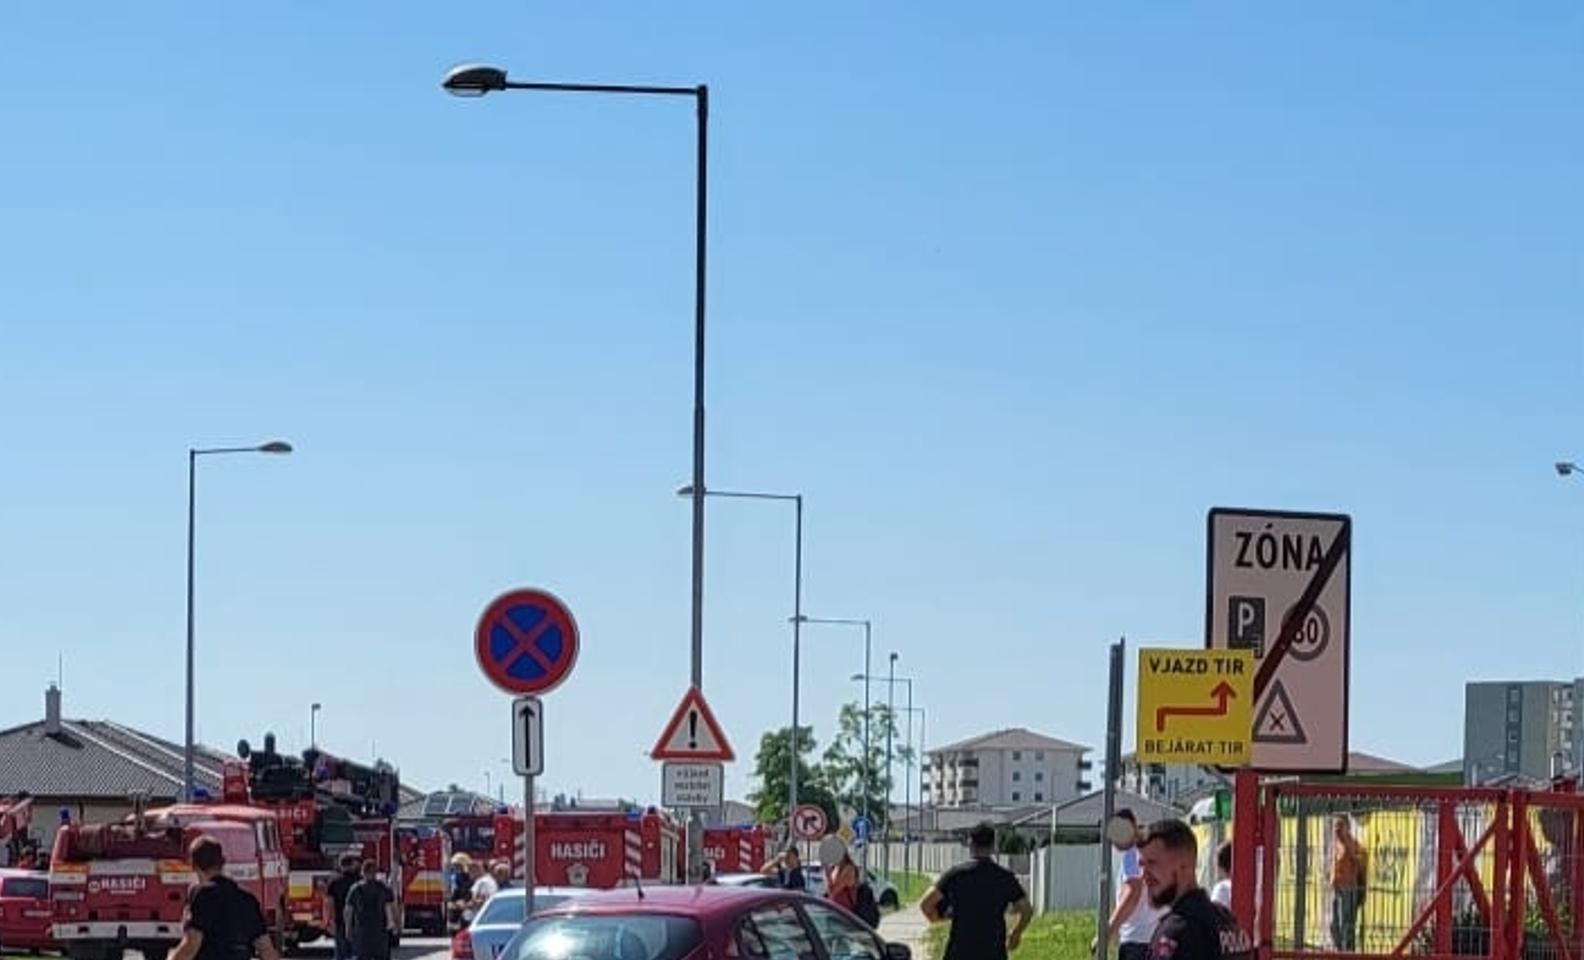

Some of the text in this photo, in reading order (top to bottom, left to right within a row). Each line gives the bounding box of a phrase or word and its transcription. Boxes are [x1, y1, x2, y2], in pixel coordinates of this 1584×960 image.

[1234, 523, 1329, 571] ZÓNA
[1149, 658, 1244, 675] VJAZD TIR
[1144, 737, 1244, 754] BEJÁRAT TIR
[551, 837, 605, 859] HASIČI
[102, 874, 146, 889] HASIČI
